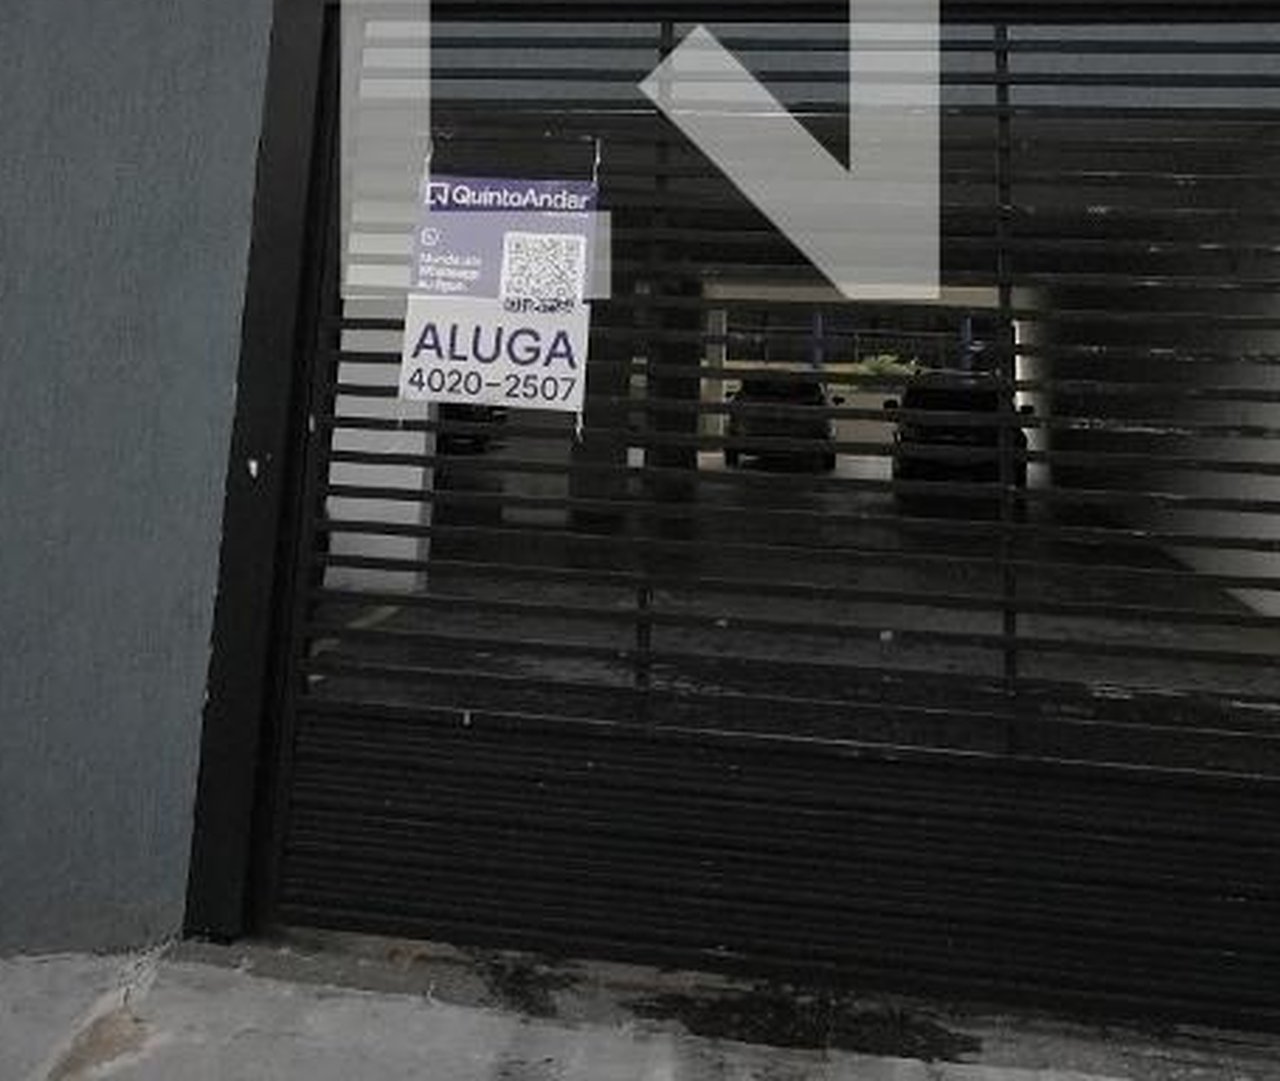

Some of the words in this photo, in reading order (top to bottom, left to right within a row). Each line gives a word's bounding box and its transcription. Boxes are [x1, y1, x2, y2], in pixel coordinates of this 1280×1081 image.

[451, 184, 590, 210] QuintoAndar
[411, 322, 577, 370] ALUGA
[408, 368, 577, 401] 4020-2507
